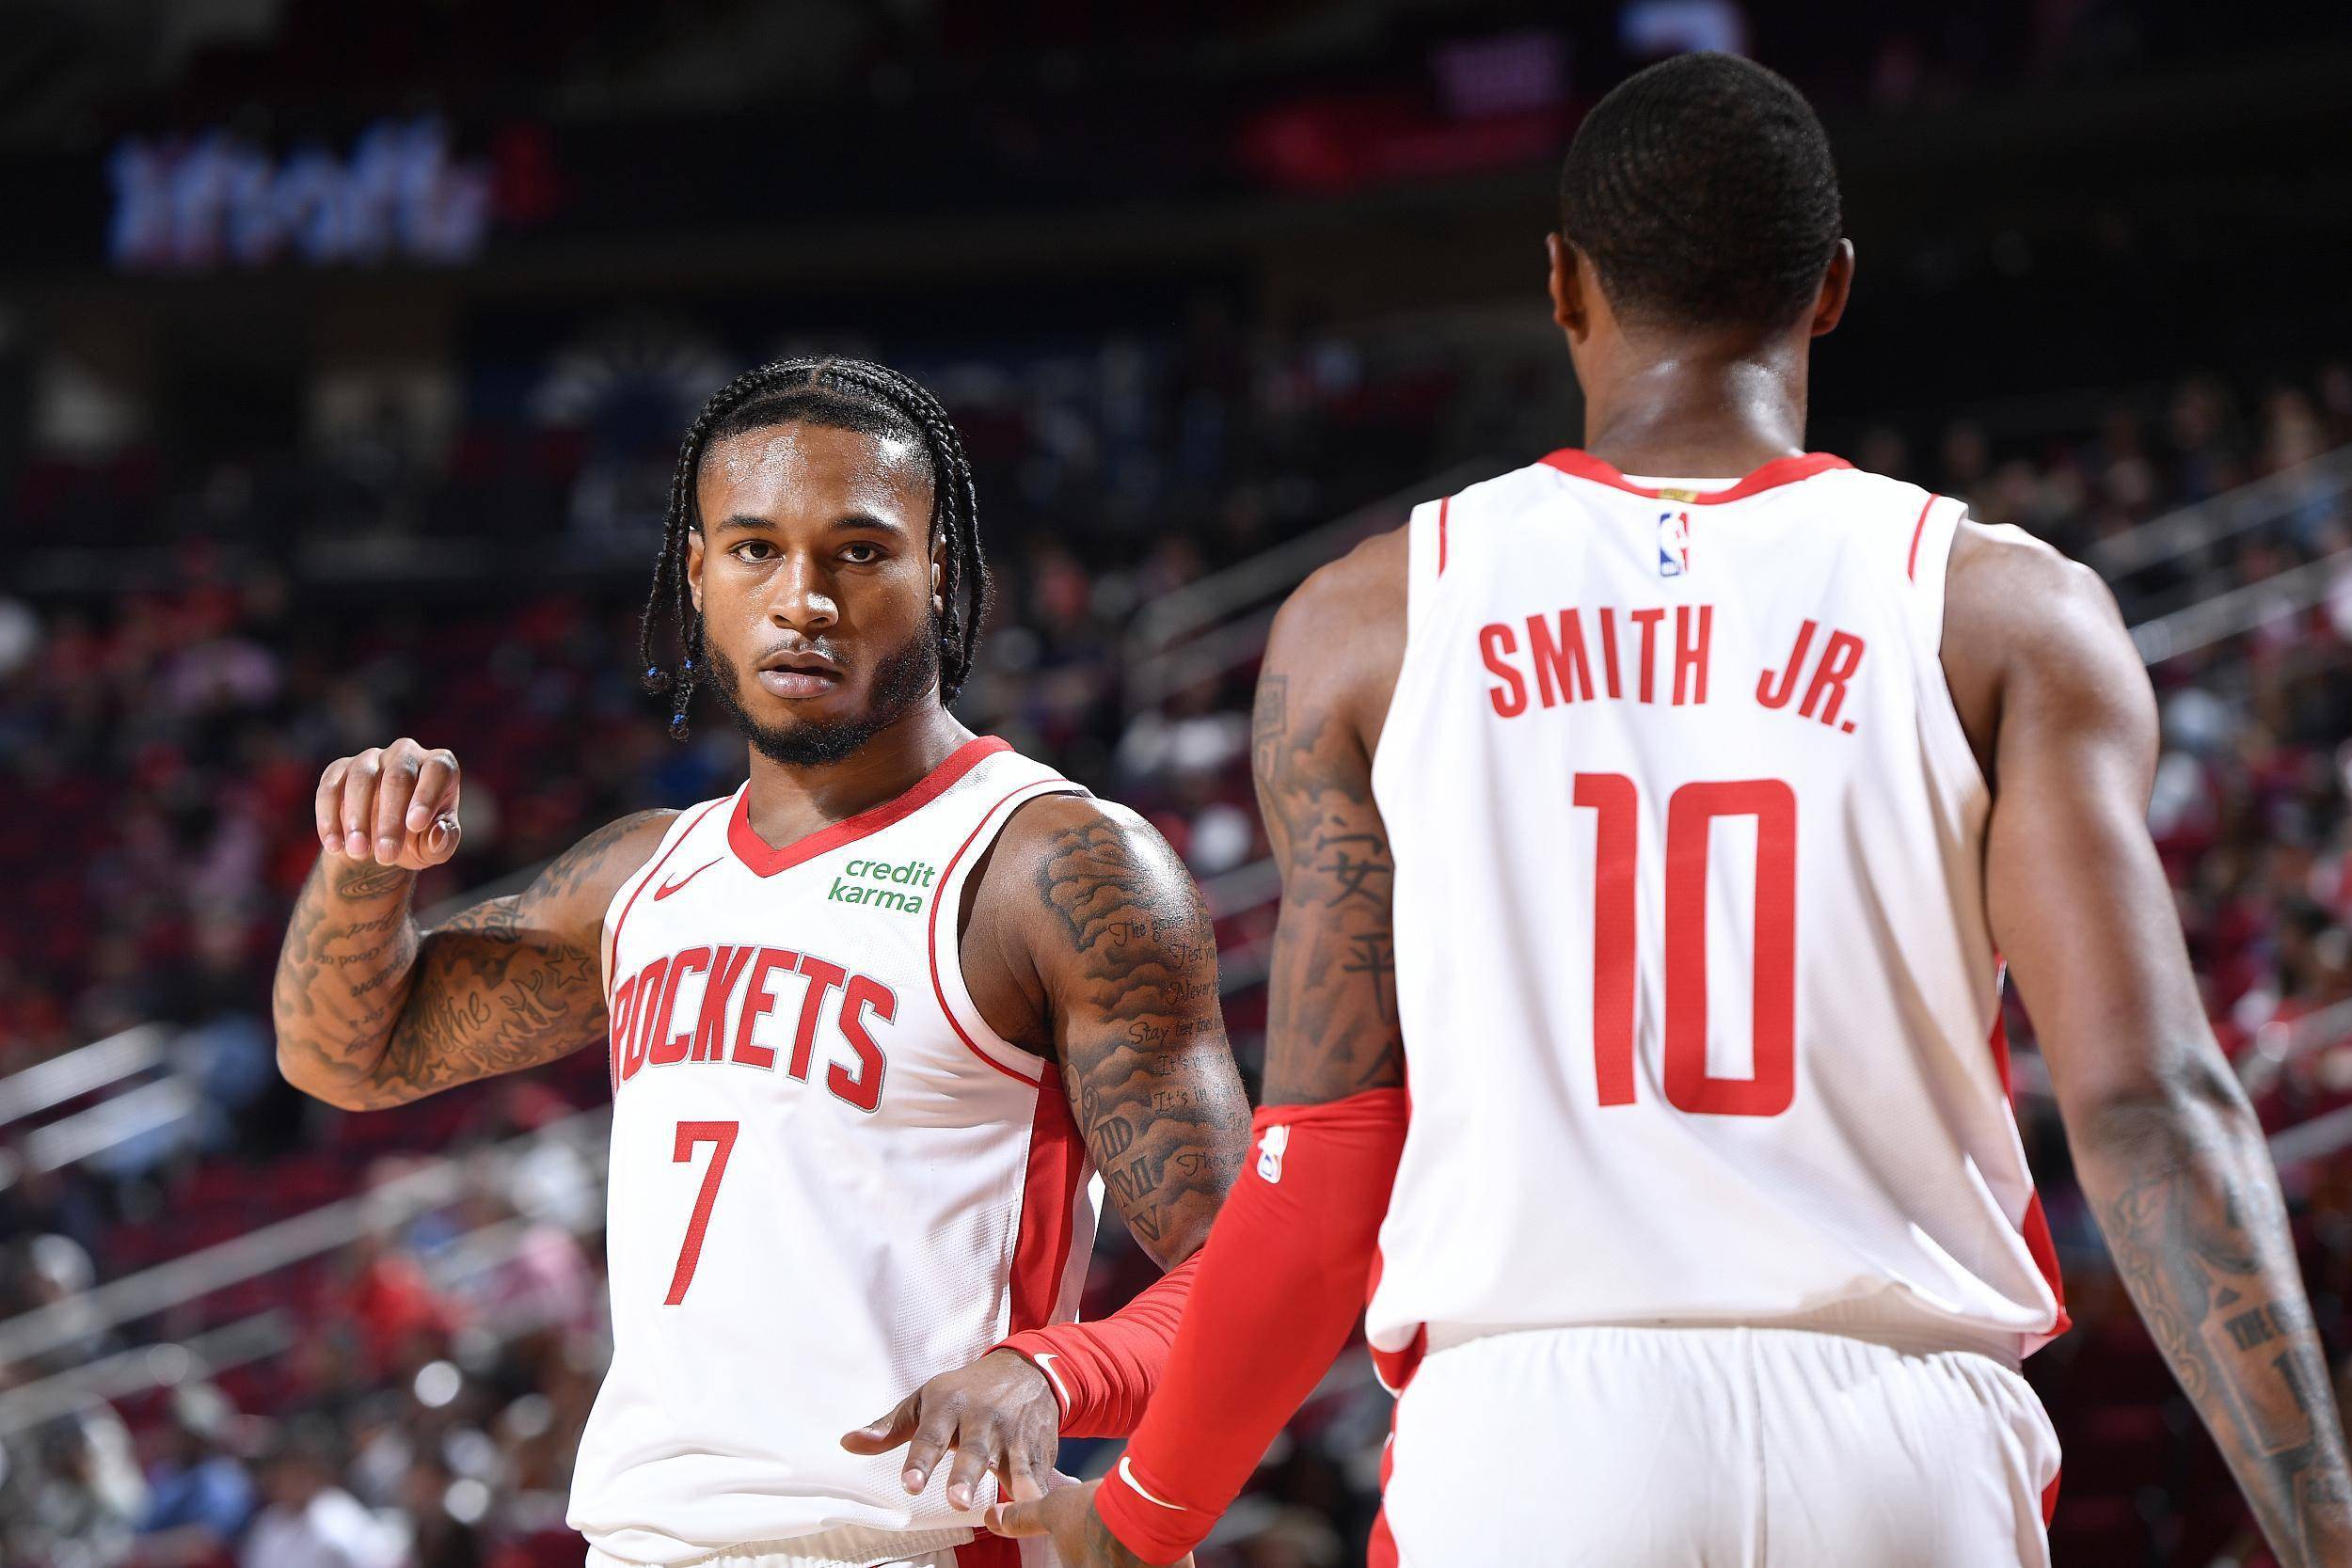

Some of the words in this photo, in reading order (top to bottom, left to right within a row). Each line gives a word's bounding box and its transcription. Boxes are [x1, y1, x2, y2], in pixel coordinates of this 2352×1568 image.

[1478, 604, 1715, 719] SMITH
[1756, 619, 1866, 735] JR.
[846, 860, 935, 887] credit
[828, 877, 923, 913] karma
[1108, 921, 1147, 946] The
[1573, 772, 1797, 1117] 10
[612, 944, 898, 1114] ROCKETS
[1129, 1022, 1169, 1047] Stay
[1153, 1089, 1188, 1112] It's
[663, 1120, 739, 1306] 7
